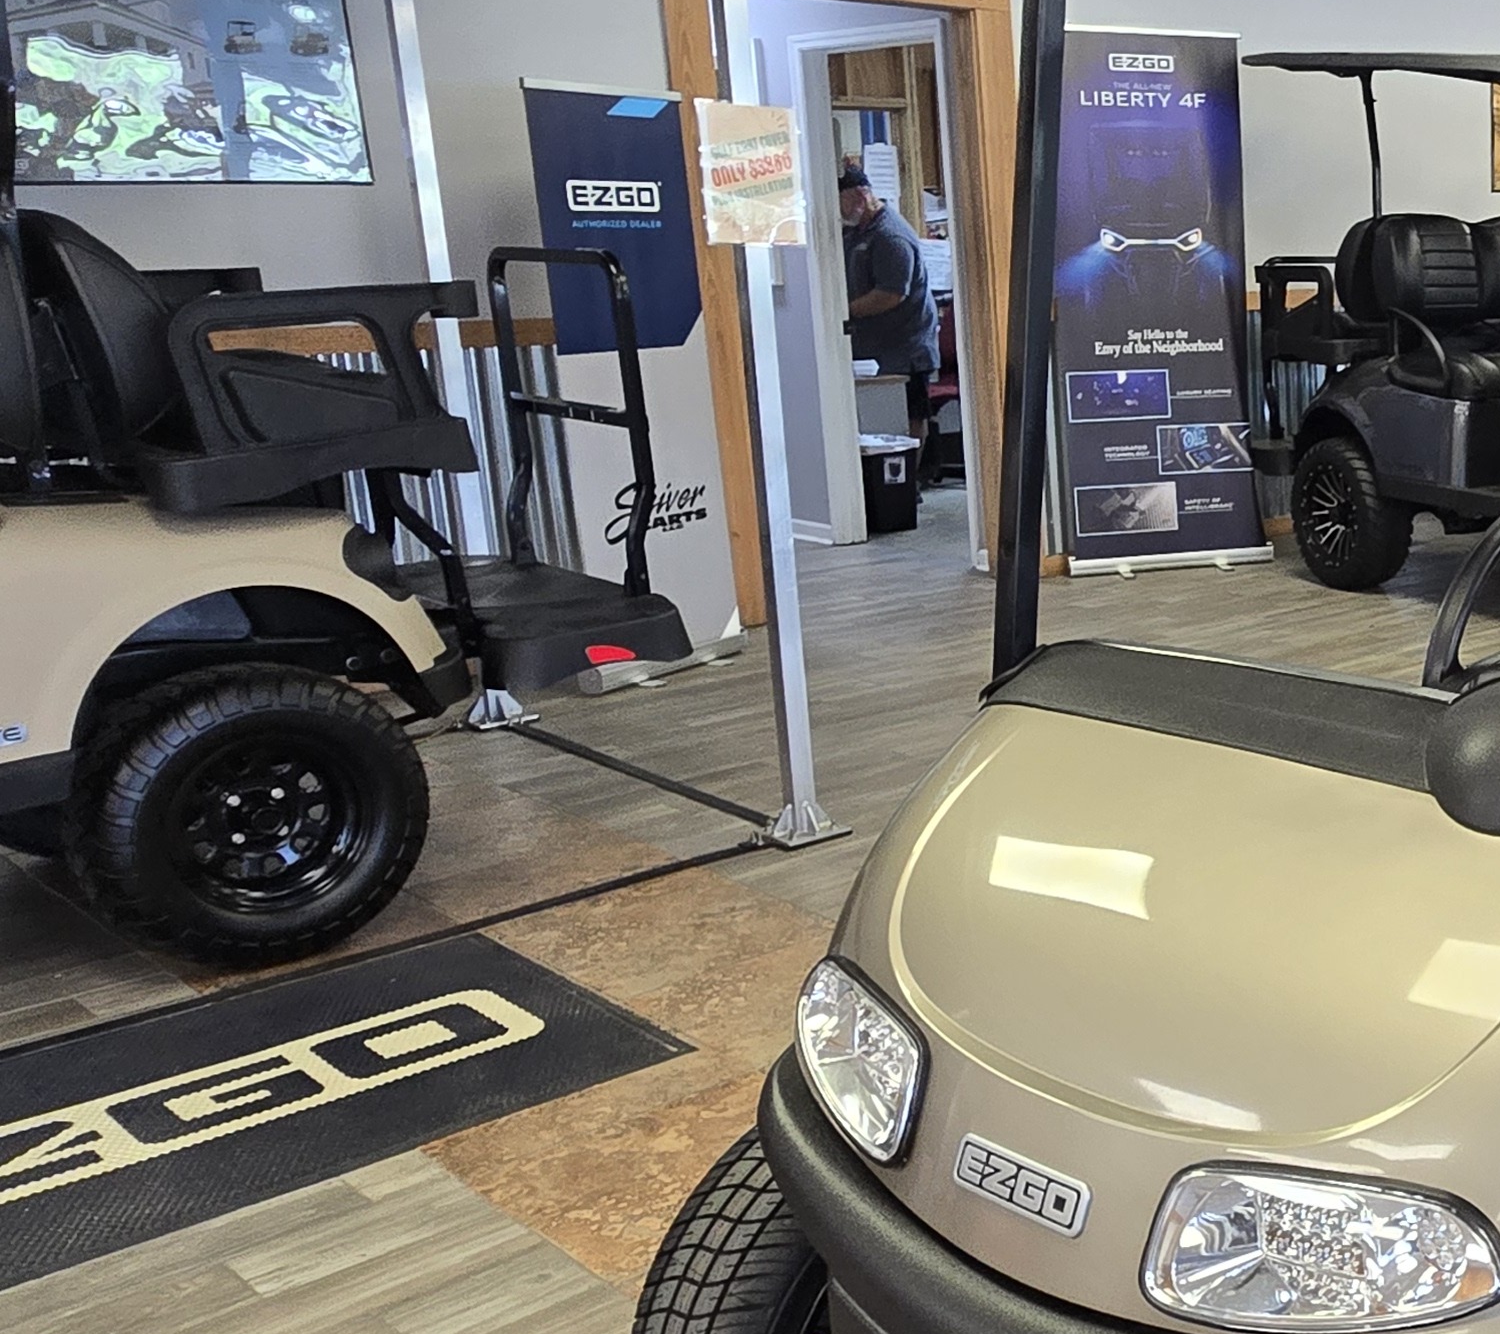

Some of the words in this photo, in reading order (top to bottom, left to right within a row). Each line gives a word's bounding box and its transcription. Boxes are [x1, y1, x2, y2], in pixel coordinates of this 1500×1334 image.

[1111, 55, 1172, 71] EZGO
[1079, 90, 1171, 108] LIBERTY
[1178, 93, 1206, 108] 4F
[711, 162, 746, 187] ONLY
[569, 183, 658, 208] EZGO
[572, 219, 627, 228] AUTHORIZED
[630, 220, 662, 228] DEALER
[1143, 329, 1165, 340] Hello
[1095, 342, 1121, 358] Envy
[1122, 341, 1134, 354] of
[1134, 342, 1151, 354] the
[1153, 338, 1223, 356] Neighborhood
[646, 508, 707, 530] ARTS
[957, 1142, 1082, 1229] EZGO
